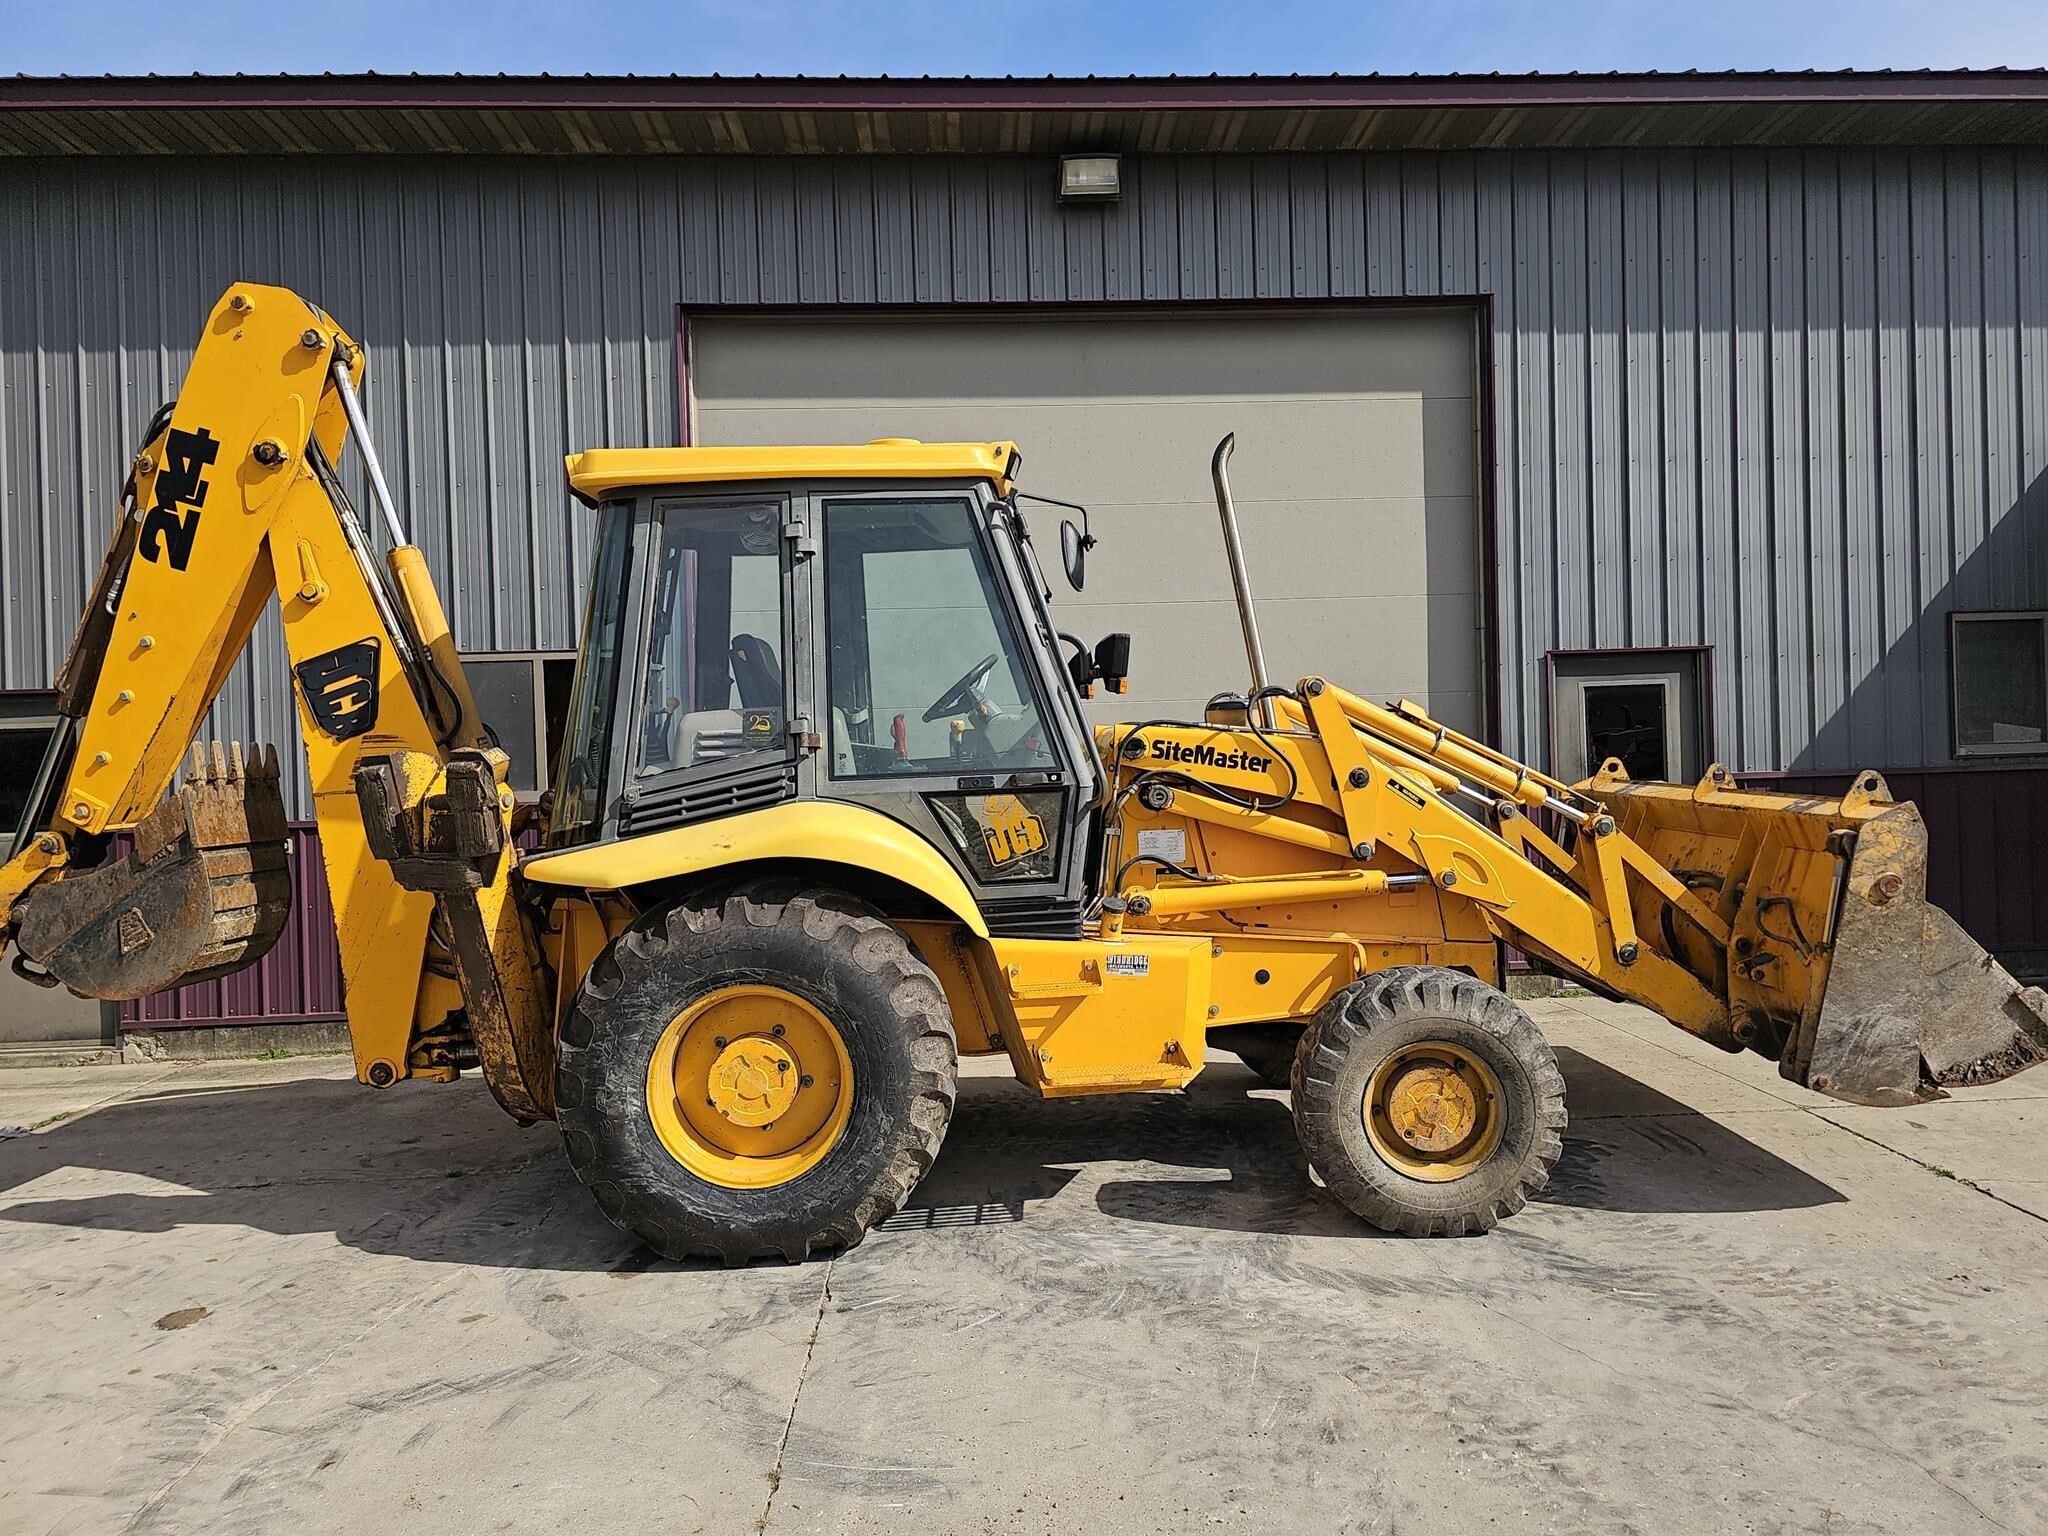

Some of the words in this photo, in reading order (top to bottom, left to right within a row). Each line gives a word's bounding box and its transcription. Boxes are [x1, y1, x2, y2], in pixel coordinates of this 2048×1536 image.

[138, 427, 220, 572] 214
[296, 641, 379, 740] JCB
[1151, 739, 1272, 774] SiteMaster
[987, 817, 1044, 863] JCB
